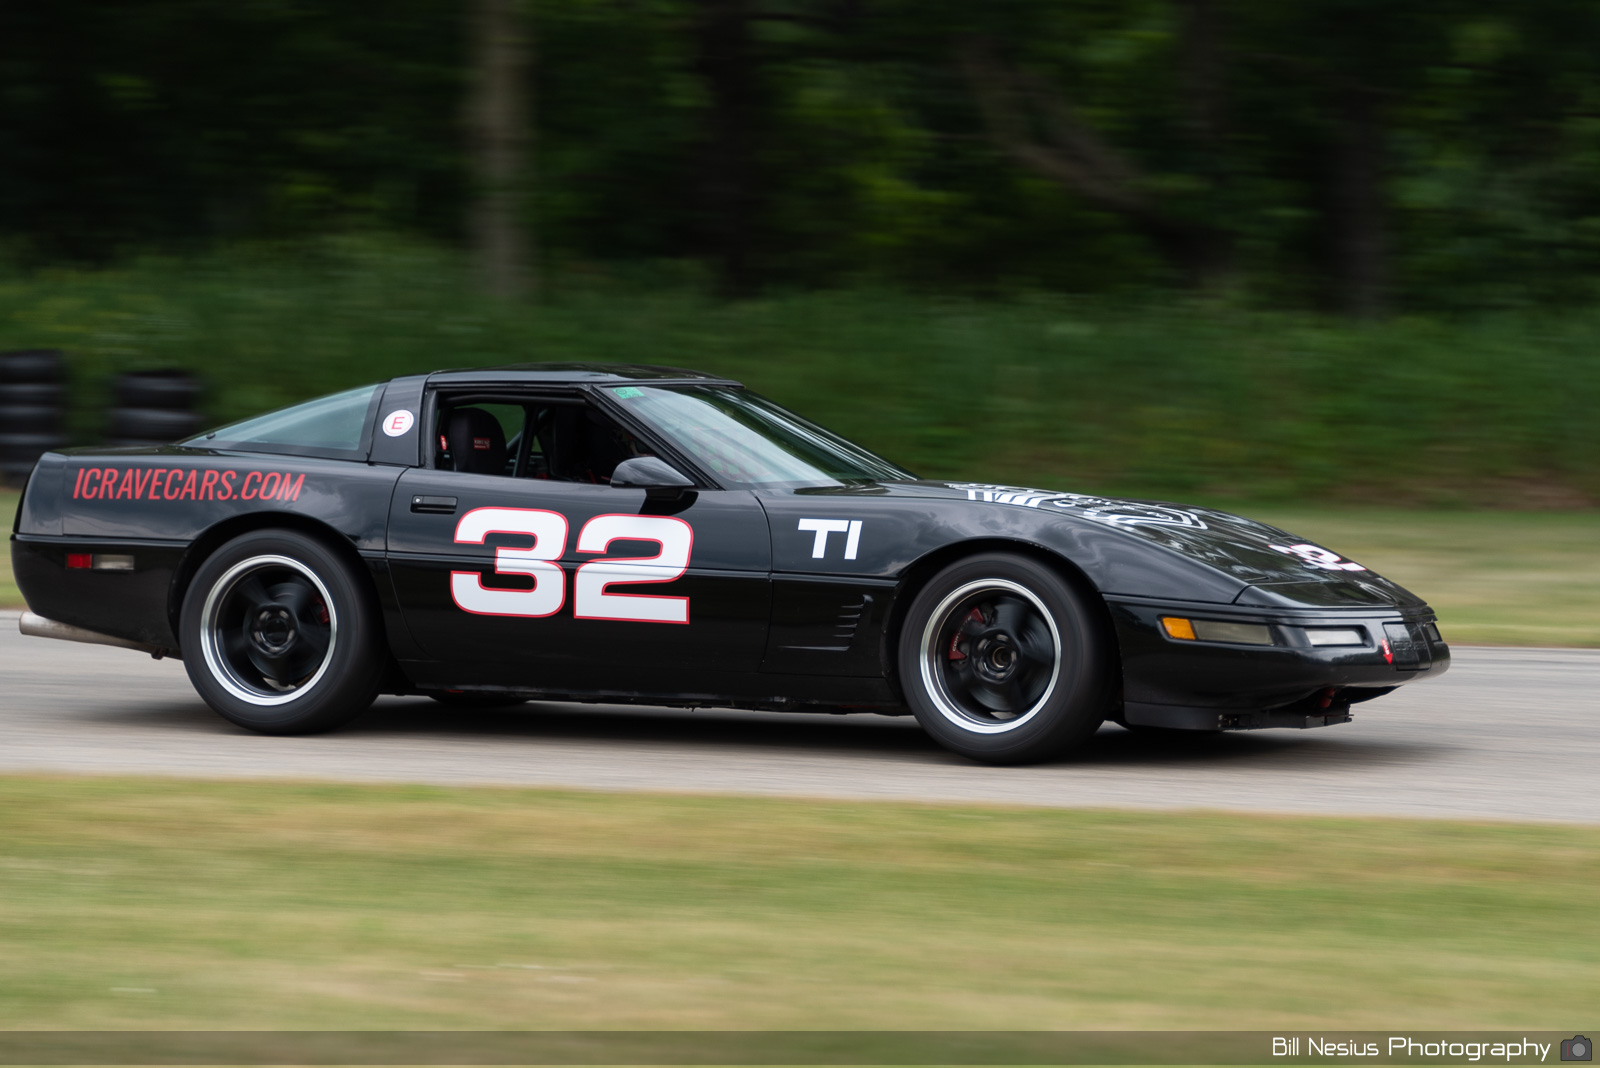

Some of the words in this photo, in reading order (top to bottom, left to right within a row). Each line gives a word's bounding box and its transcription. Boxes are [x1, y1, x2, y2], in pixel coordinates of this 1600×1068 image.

[391, 416, 405, 430] E
[73, 468, 305, 501] ICRAVECARS.COM
[797, 518, 863, 561] TI
[451, 506, 694, 625] 32
